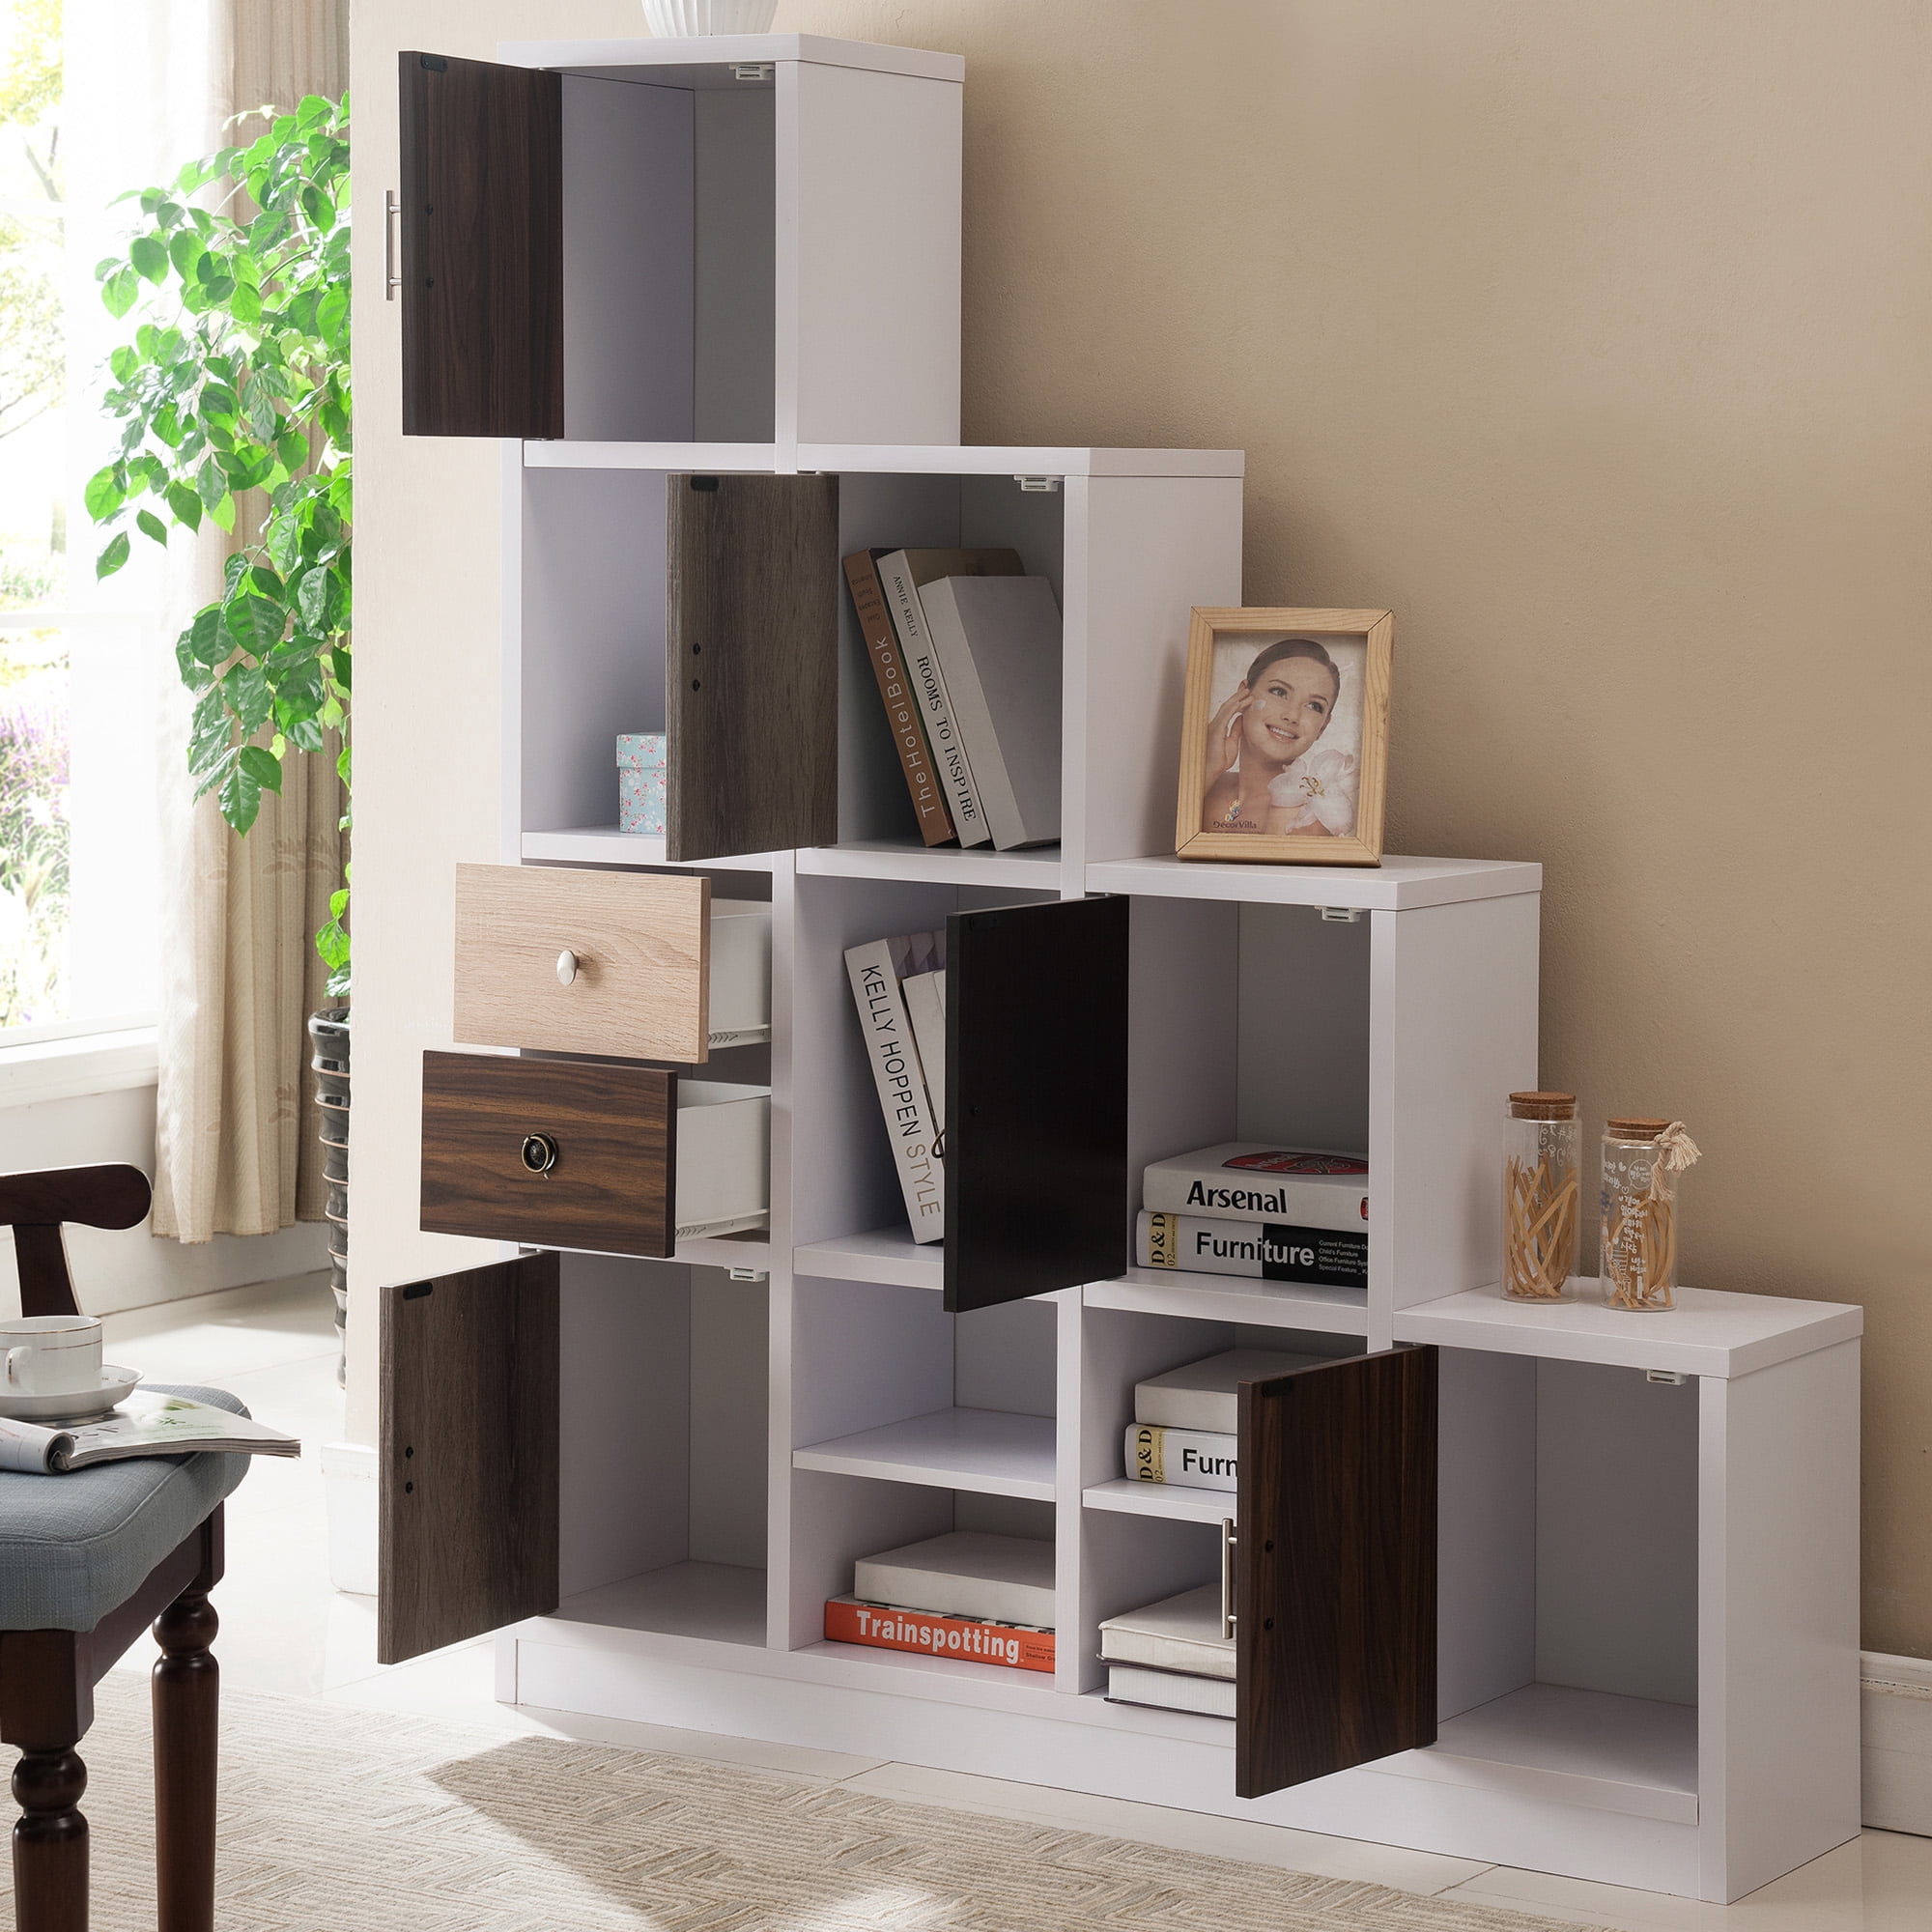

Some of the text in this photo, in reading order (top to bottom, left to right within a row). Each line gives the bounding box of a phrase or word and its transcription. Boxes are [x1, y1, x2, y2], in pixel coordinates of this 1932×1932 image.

[893, 576, 919, 638] ANNIE KELLY
[874, 636, 901, 698] Book
[917, 656, 977, 821] ROOMS TO INSPIRE
[916, 772, 935, 819] The
[861, 965, 941, 1218] KELLY HOPPEN STYLE
[1186, 1180, 1288, 1214] Arsenal
[1151, 1250, 1165, 1264] D
[1167, 1254, 1175, 1265] 02
[1197, 1231, 1315, 1266] Furniture
[1338, 1241, 1361, 1250] Furniture
[1139, 1430, 1151, 1443] D
[1140, 1466, 1153, 1480] D
[1154, 1469, 1163, 1482] 02
[1182, 1448, 1237, 1477] Furn
[857, 1610, 1019, 1664] Trainspotting
